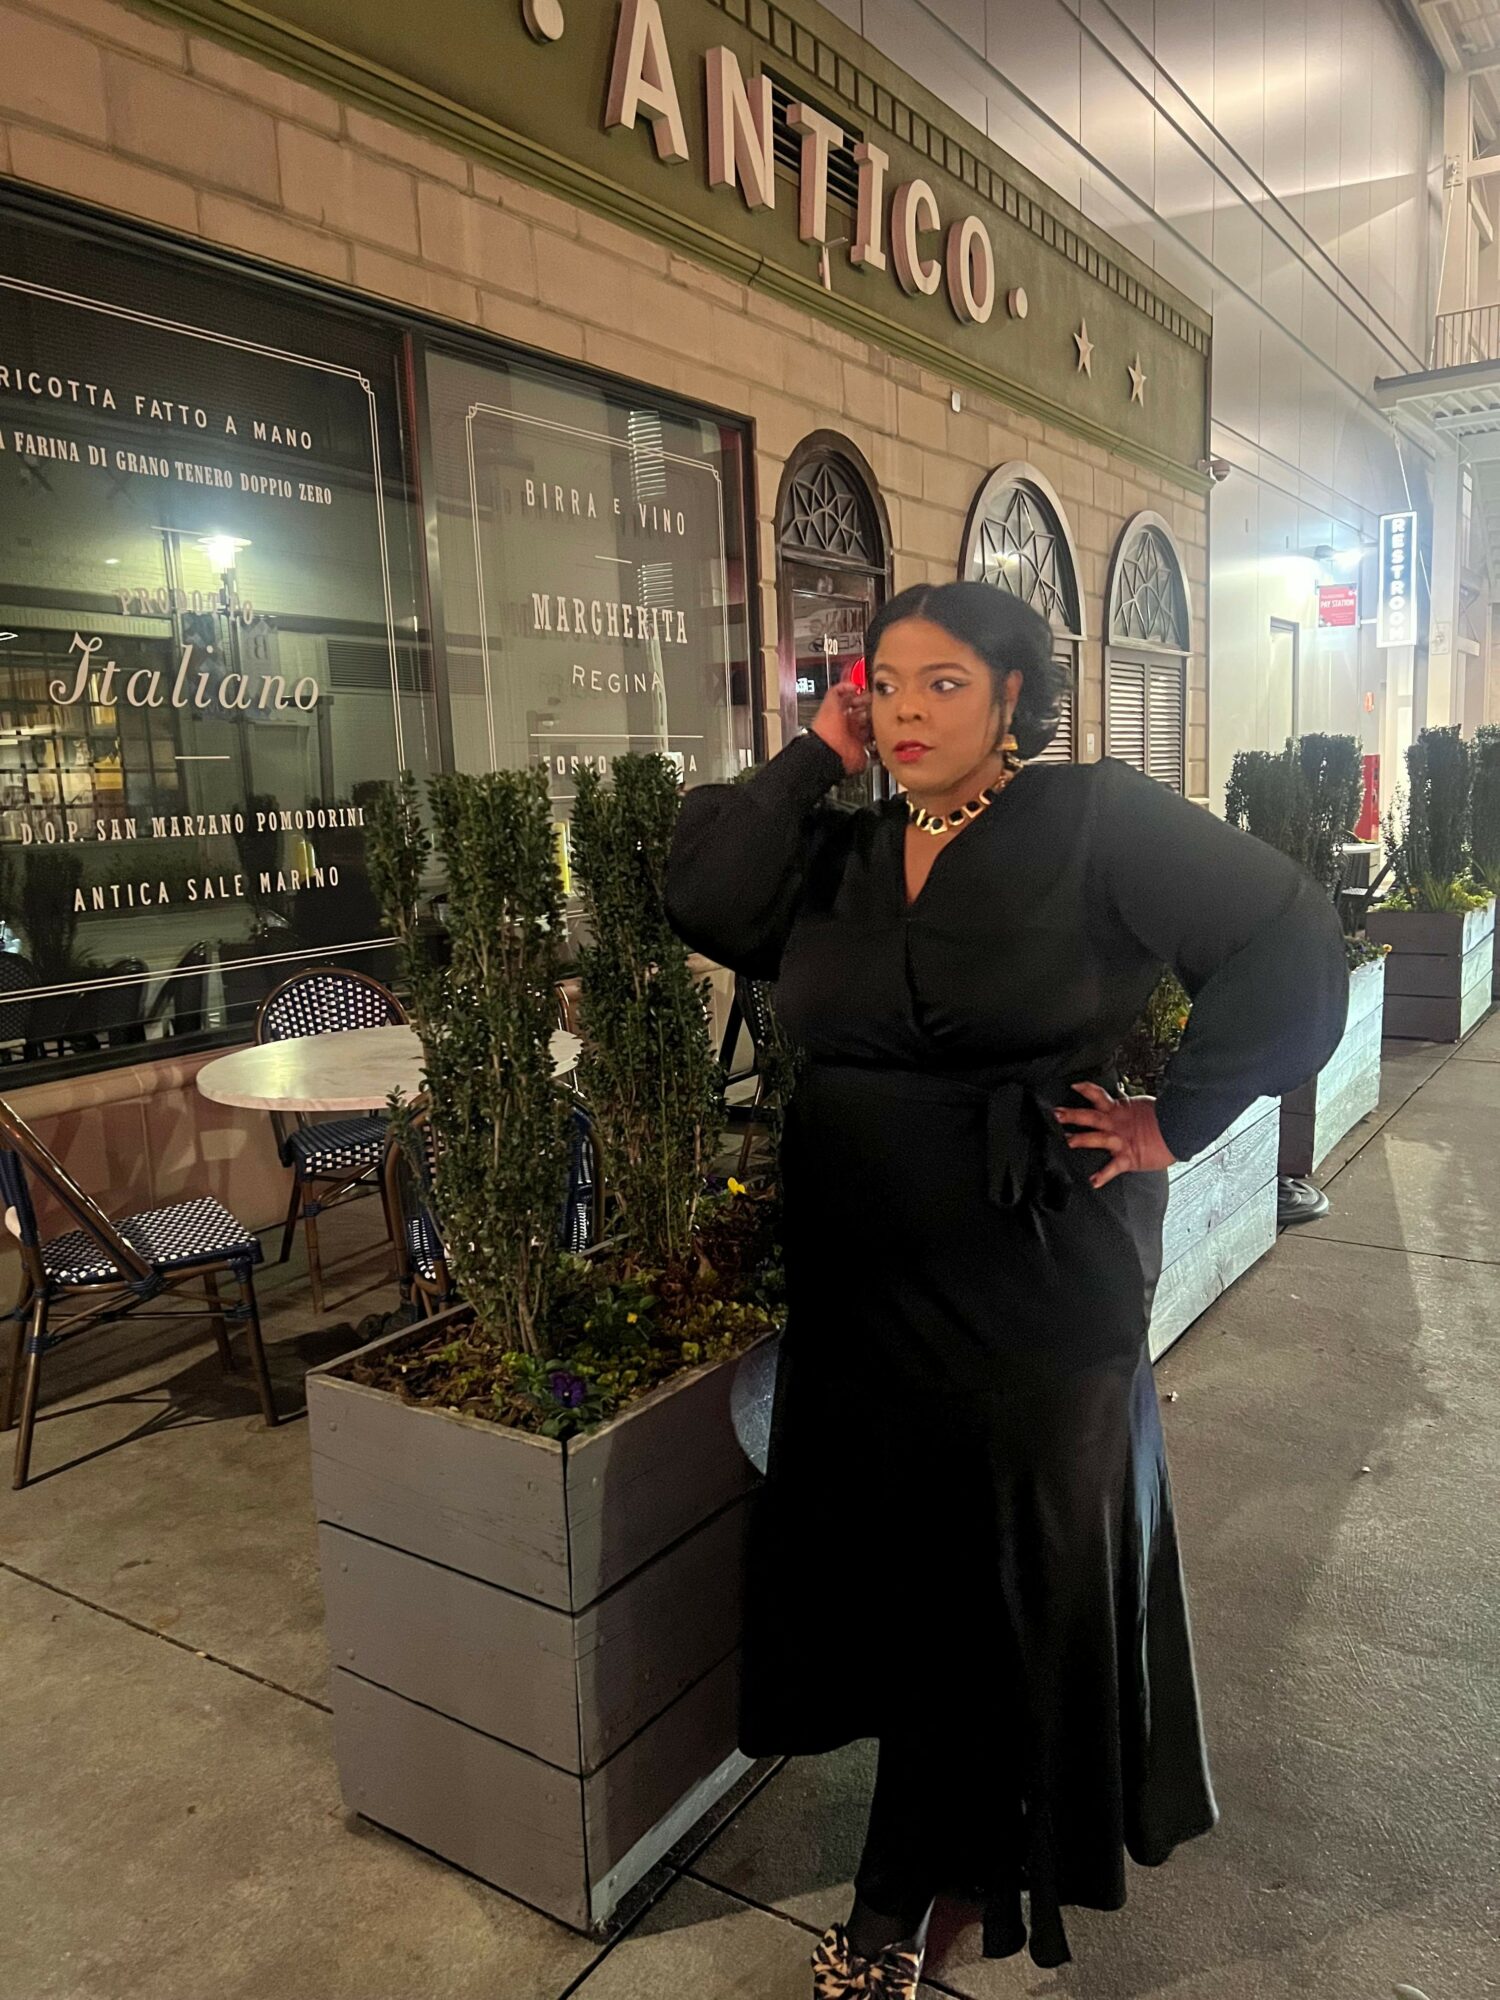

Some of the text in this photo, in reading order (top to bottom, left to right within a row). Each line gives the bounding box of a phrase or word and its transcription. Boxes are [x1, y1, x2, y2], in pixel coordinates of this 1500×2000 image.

[604, 0, 996, 324] ANTICO
[0, 365, 313, 450] RICOTTA FATTO A MANO
[14, 431, 80, 463] FARINA
[88, 444, 107, 467] DI
[116, 451, 169, 478] GRANO
[175, 461, 233, 489] TENERO
[240, 473, 292, 498] DOPPIO
[299, 483, 332, 505] ZERO
[525, 479, 685, 536] BIRRA E VINO
[1320, 598, 1354, 608] PAY STATION
[1388, 517, 1406, 641] RESTROOM
[531, 593, 688, 644] MARGHERITA
[49, 632, 319, 711] Italiano
[572, 664, 664, 693] REGINA
[20, 807, 366, 846] D.O.P. SAN MARZANO POMODORINI
[73, 866, 340, 912] ANTICA SALE MARINO
